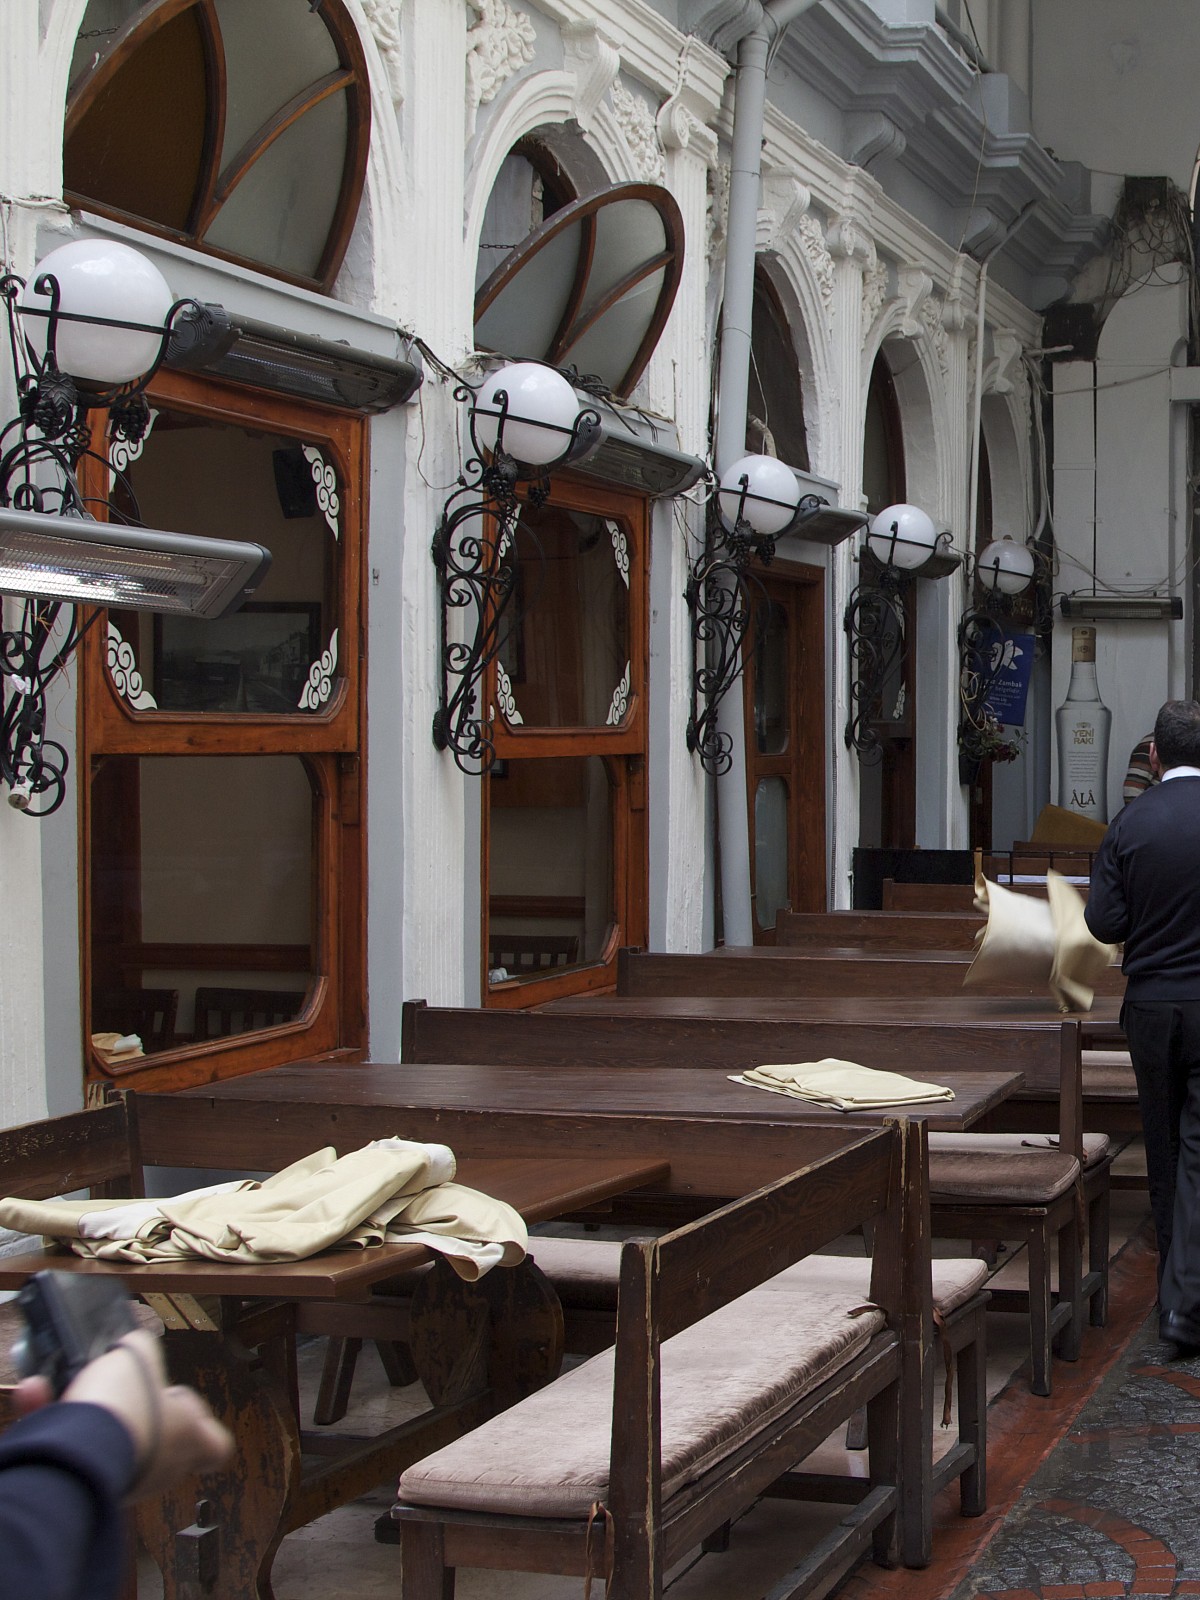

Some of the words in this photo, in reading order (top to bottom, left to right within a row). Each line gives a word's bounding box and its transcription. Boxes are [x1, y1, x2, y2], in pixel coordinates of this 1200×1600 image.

[998, 679, 1022, 688] Zambak
[1072, 728, 1094, 737] YENİ
[1073, 737, 1094, 745] RAKI
